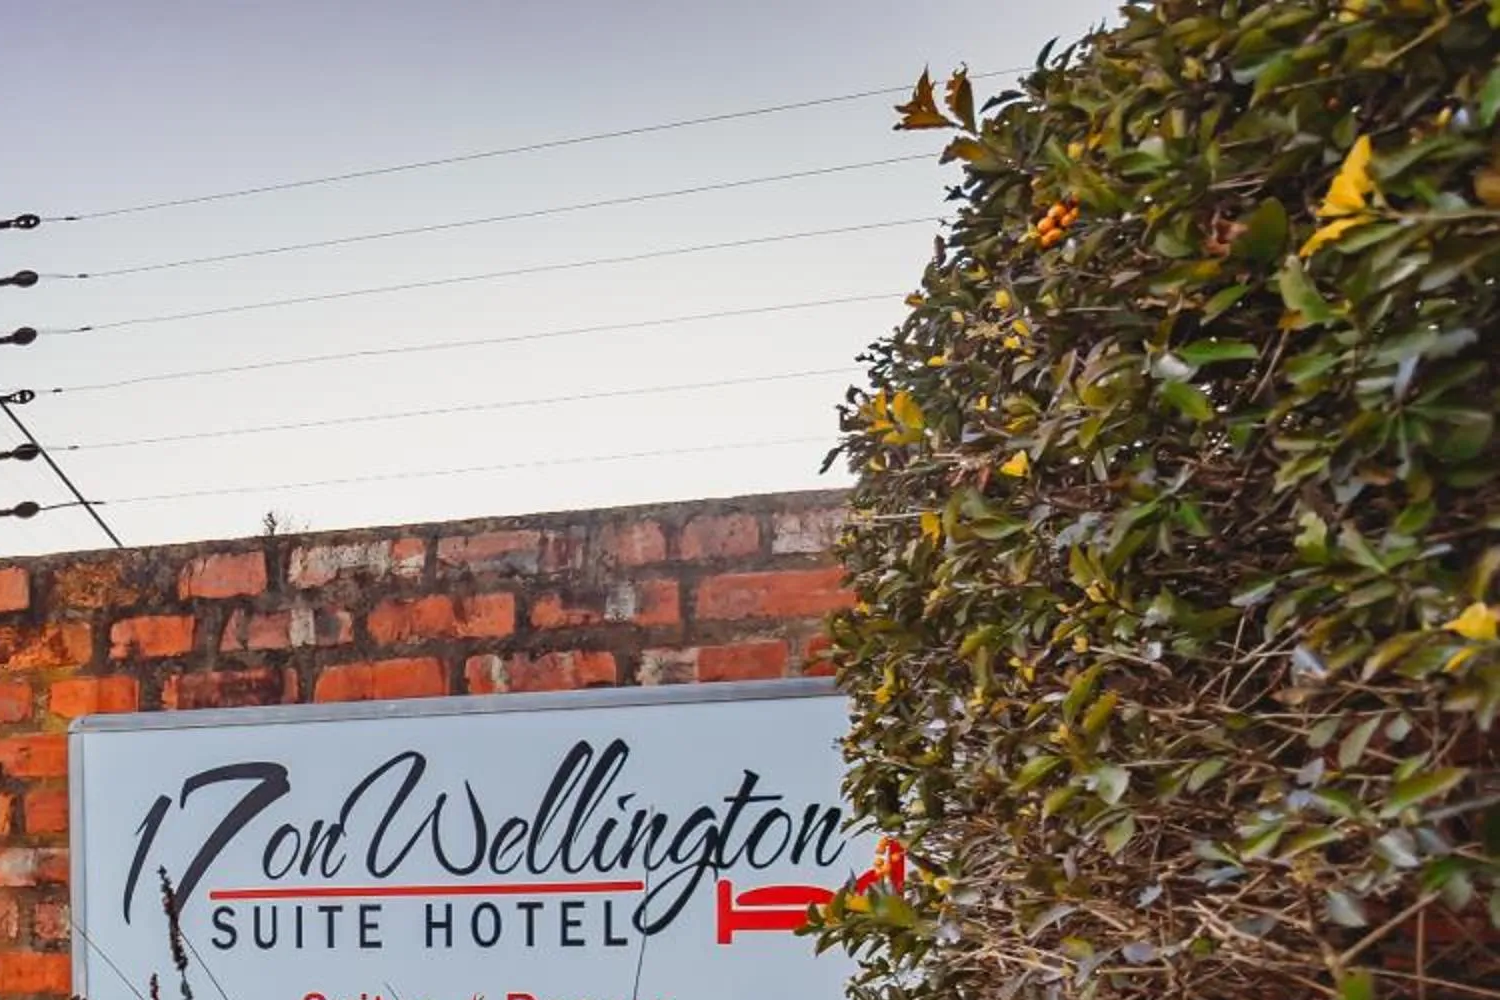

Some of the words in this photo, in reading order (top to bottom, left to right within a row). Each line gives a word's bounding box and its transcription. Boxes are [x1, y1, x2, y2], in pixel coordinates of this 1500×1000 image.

[124, 761, 290, 925] 17
[263, 819, 346, 880] on
[340, 738, 846, 936] Wellington
[212, 904, 382, 950] SUITE
[426, 900, 628, 949] HOTEL
